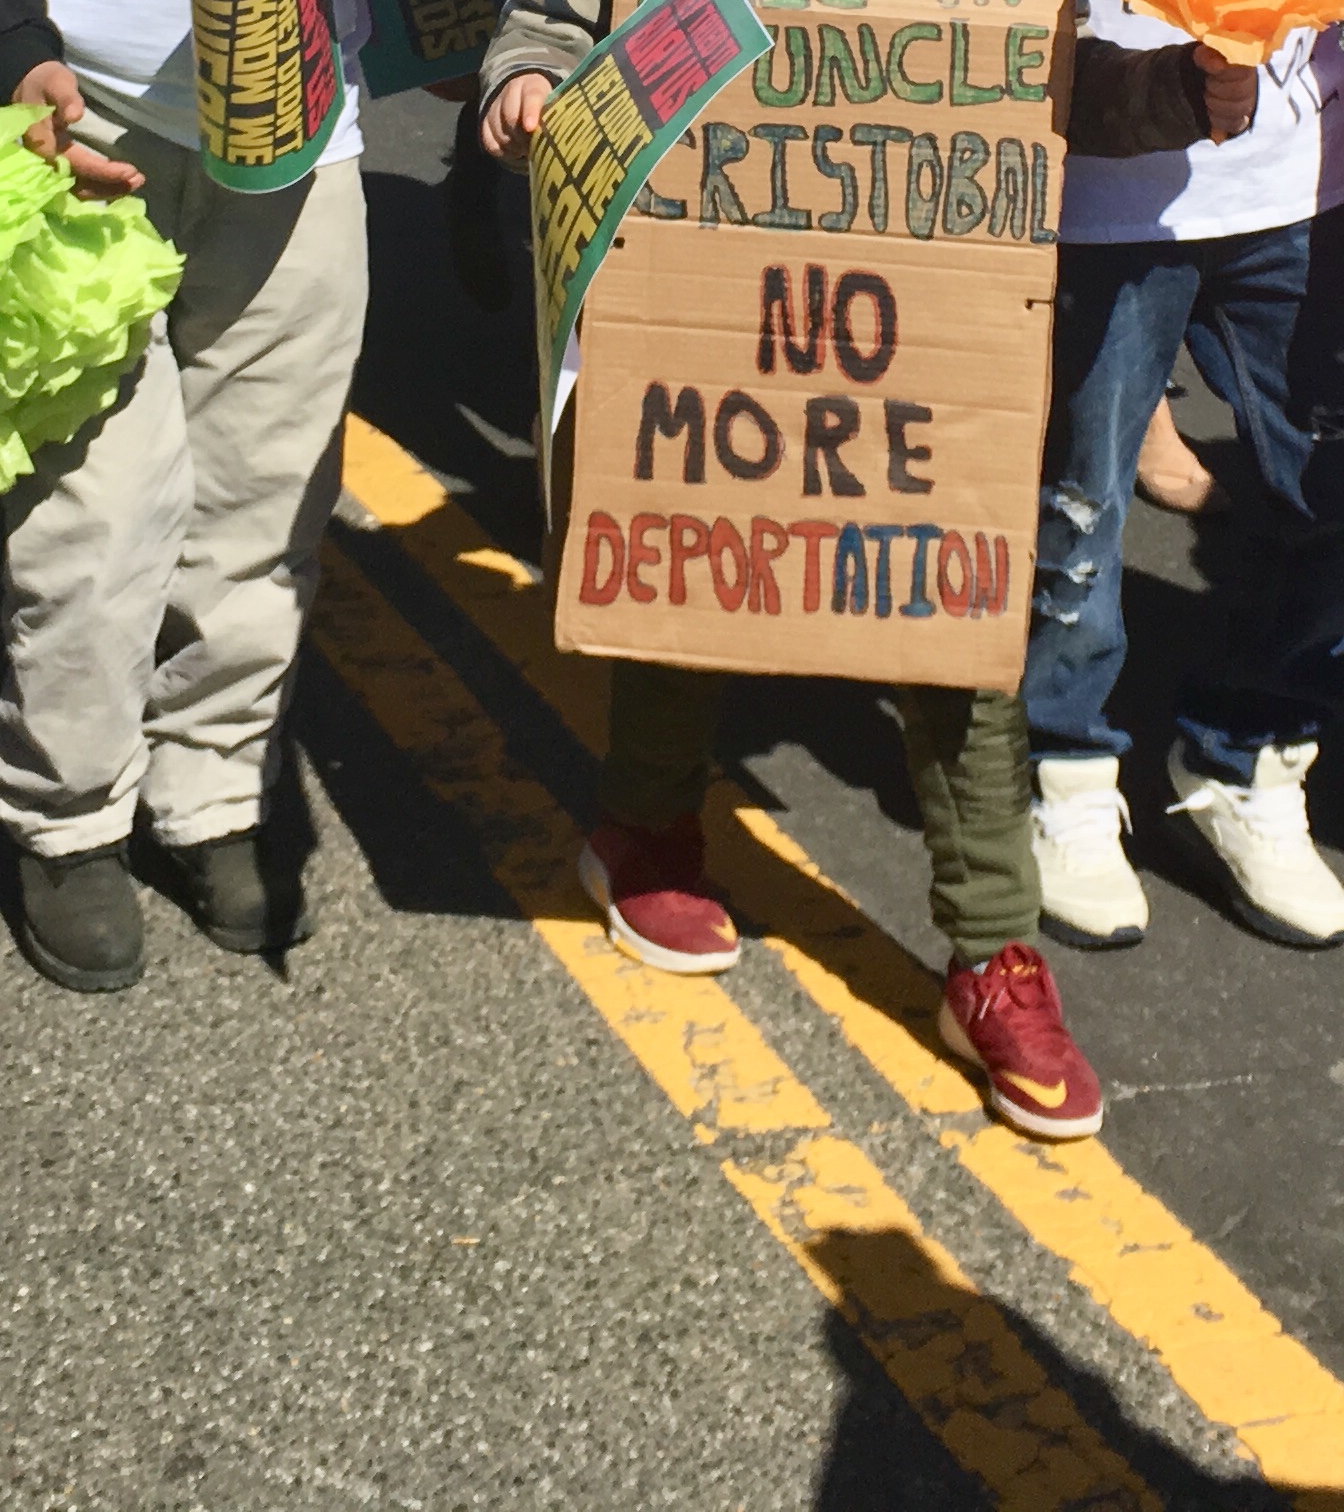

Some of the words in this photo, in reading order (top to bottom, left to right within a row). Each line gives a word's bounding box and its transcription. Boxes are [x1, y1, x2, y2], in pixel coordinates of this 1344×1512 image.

[276, 53, 304, 156] DIDN'T
[753, 18, 1050, 108] UNCLE
[227, 114, 275, 167] WE
[541, 85, 607, 177] KNOW
[579, 147, 626, 220] WE
[756, 264, 898, 384] NO
[634, 382, 936, 498] MORE
[579, 510, 1010, 620] DEPORTATION
